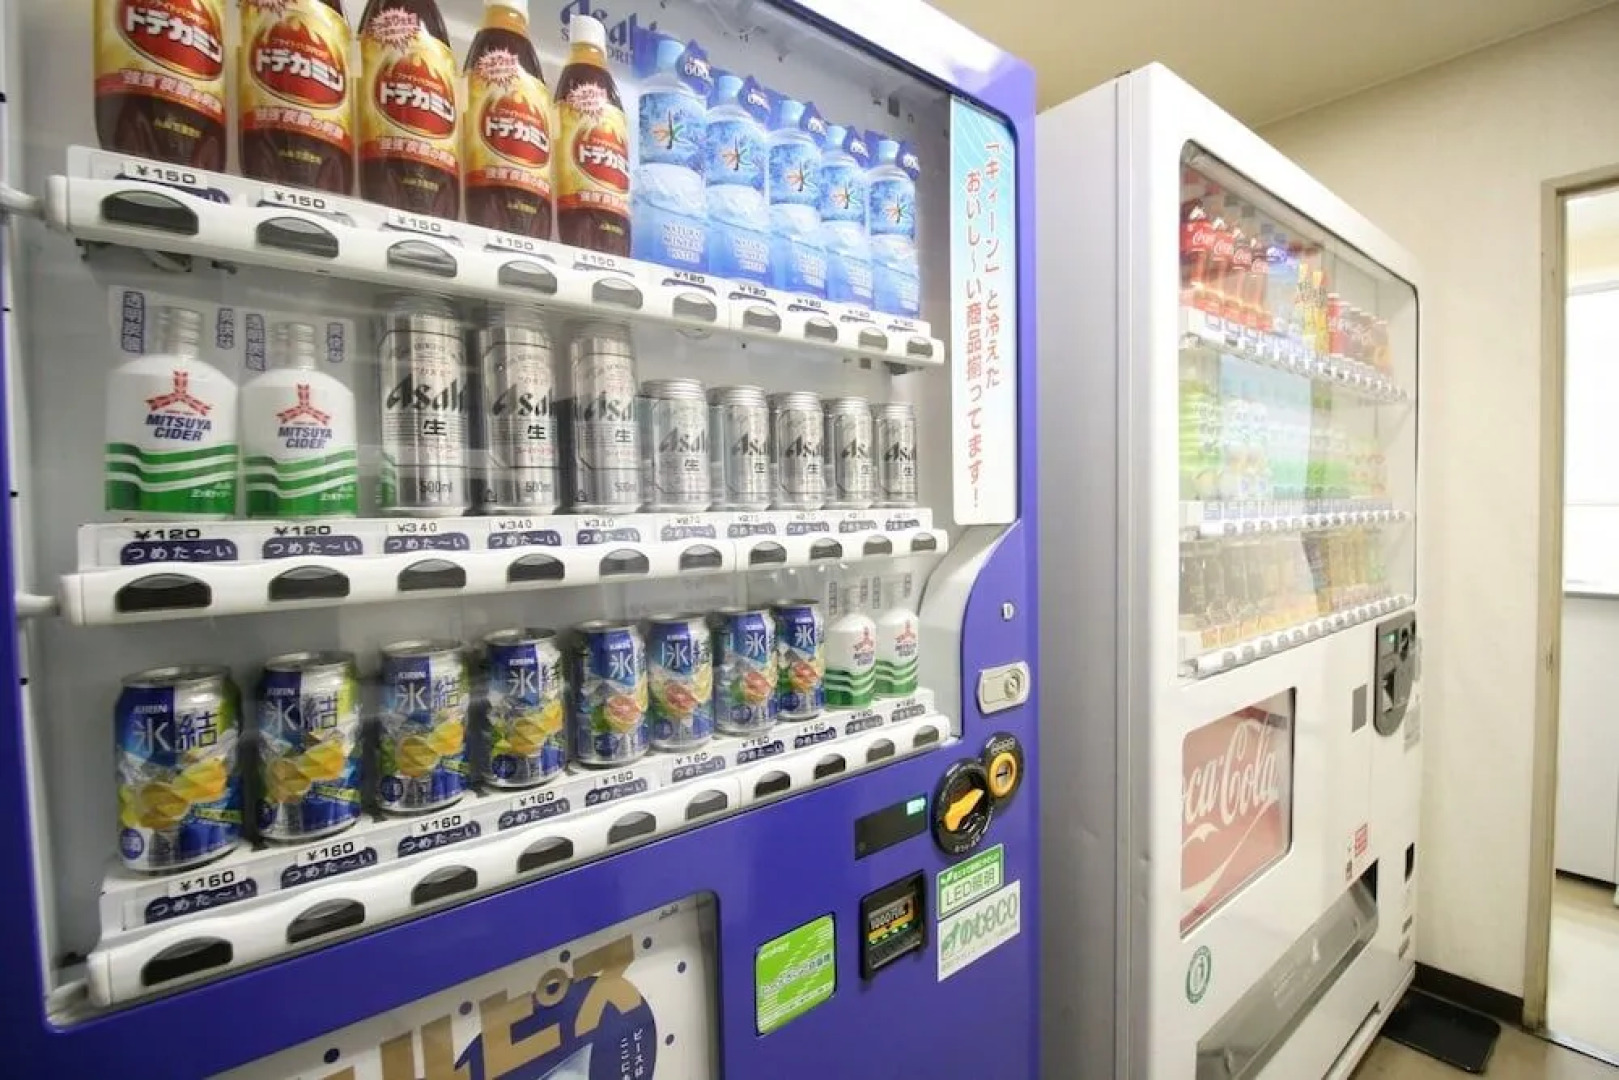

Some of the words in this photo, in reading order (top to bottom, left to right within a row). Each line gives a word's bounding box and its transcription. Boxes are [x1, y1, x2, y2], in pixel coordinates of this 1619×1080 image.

[126, 5, 223, 64] ドデカミン
[256, 48, 344, 93] ドデカミン
[380, 82, 455, 121] ドデカミン
[485, 116, 548, 153] ドデカミン
[136, 164, 197, 185] ¥150
[275, 190, 325, 210] ¥150
[397, 216, 441, 232] ¥150
[497, 237, 534, 251] ¥150
[582, 253, 615, 268] ¥150
[674, 270, 705, 284] ¥120
[739, 285, 767, 297] ¥120
[387, 374, 466, 412] Asah
[146, 413, 212, 430] MITSUYA
[423, 419, 447, 436] 生
[154, 427, 203, 441] CIDER
[278, 426, 333, 440] MITSUYA
[527, 424, 547, 440] 生
[615, 429, 633, 443] 生
[286, 438, 326, 449] CIDER
[397, 522, 437, 532] ¥340
[499, 520, 533, 530] ¥340
[584, 518, 614, 528] ¥340
[134, 529, 200, 541] ¥120
[275, 526, 331, 536] ¥120
[491, 531, 559, 546] つめた～い
[579, 530, 638, 543] つめた～い
[268, 541, 358, 555] つめた～い
[391, 537, 466, 550] つめた～い
[127, 545, 233, 560] つめた～い
[267, 687, 296, 697] KIRIN
[399, 675, 461, 715] 氷結
[133, 703, 168, 715] KIRIN
[268, 693, 338, 740] 氷結
[134, 711, 218, 752] 氷結
[742, 736, 769, 748] ¥160
[676, 753, 708, 764] ¥160
[603, 771, 633, 785] ¥160
[520, 792, 554, 805] ¥160
[587, 780, 647, 804] つめた～い
[502, 800, 568, 827] つめた～い
[421, 815, 461, 832] ¥160
[401, 822, 479, 851] つめた～い
[308, 841, 354, 861] ¥160
[287, 850, 374, 881] つめた～い
[180, 870, 235, 891] ¥160
[152, 883, 251, 916] つめた～い
[320, 934, 645, 1080] ルピス
[621, 1037, 632, 1080] ここに
